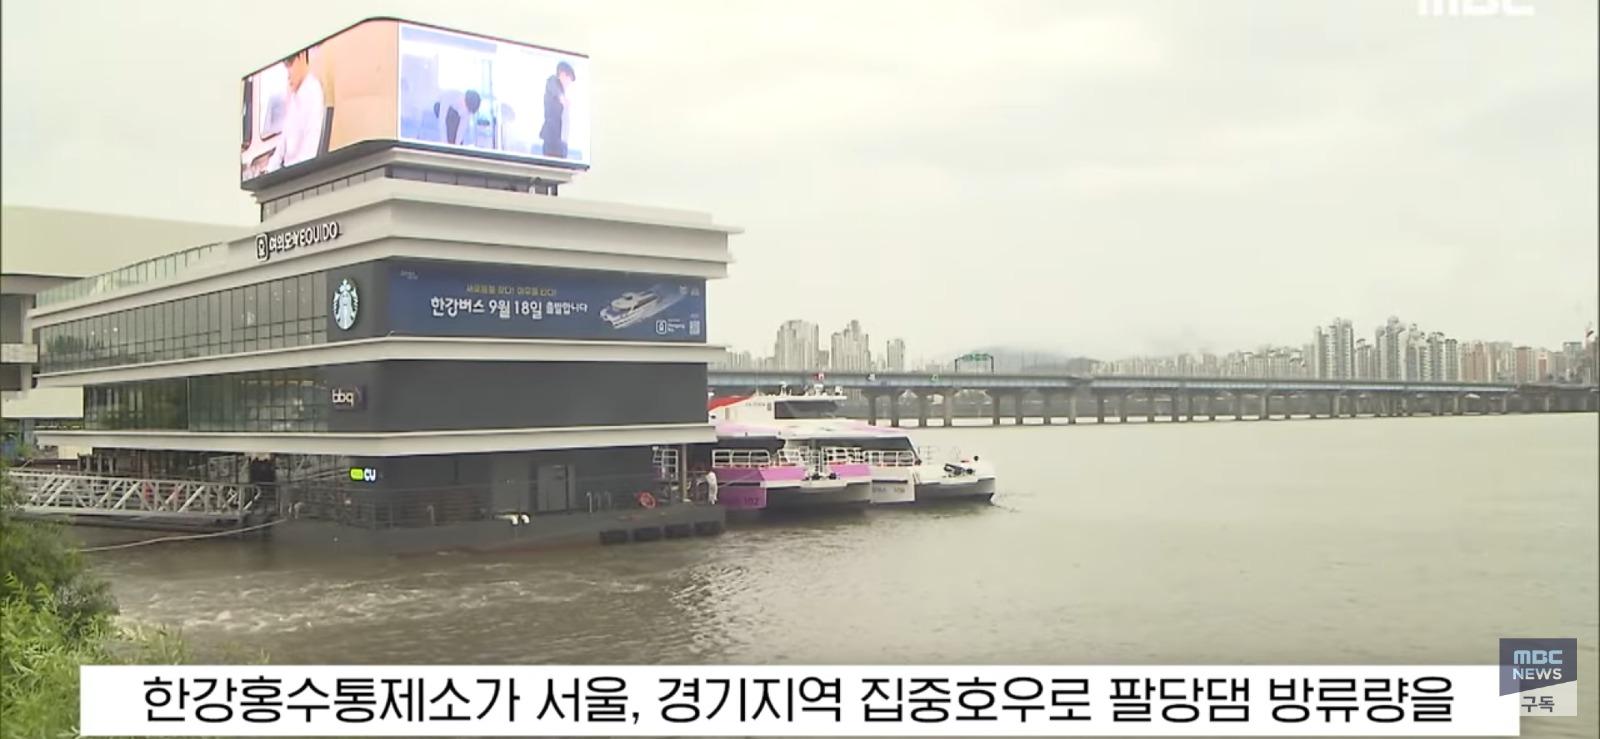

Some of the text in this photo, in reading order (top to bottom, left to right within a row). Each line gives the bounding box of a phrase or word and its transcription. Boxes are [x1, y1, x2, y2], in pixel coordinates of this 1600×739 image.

[293, 221, 337, 246] YEOUIDO
[431, 295, 486, 317] 한강버스
[489, 299, 511, 319] 9월
[514, 300, 543, 320] 18일
[331, 388, 354, 408] bbq
[364, 467, 376, 481] CU
